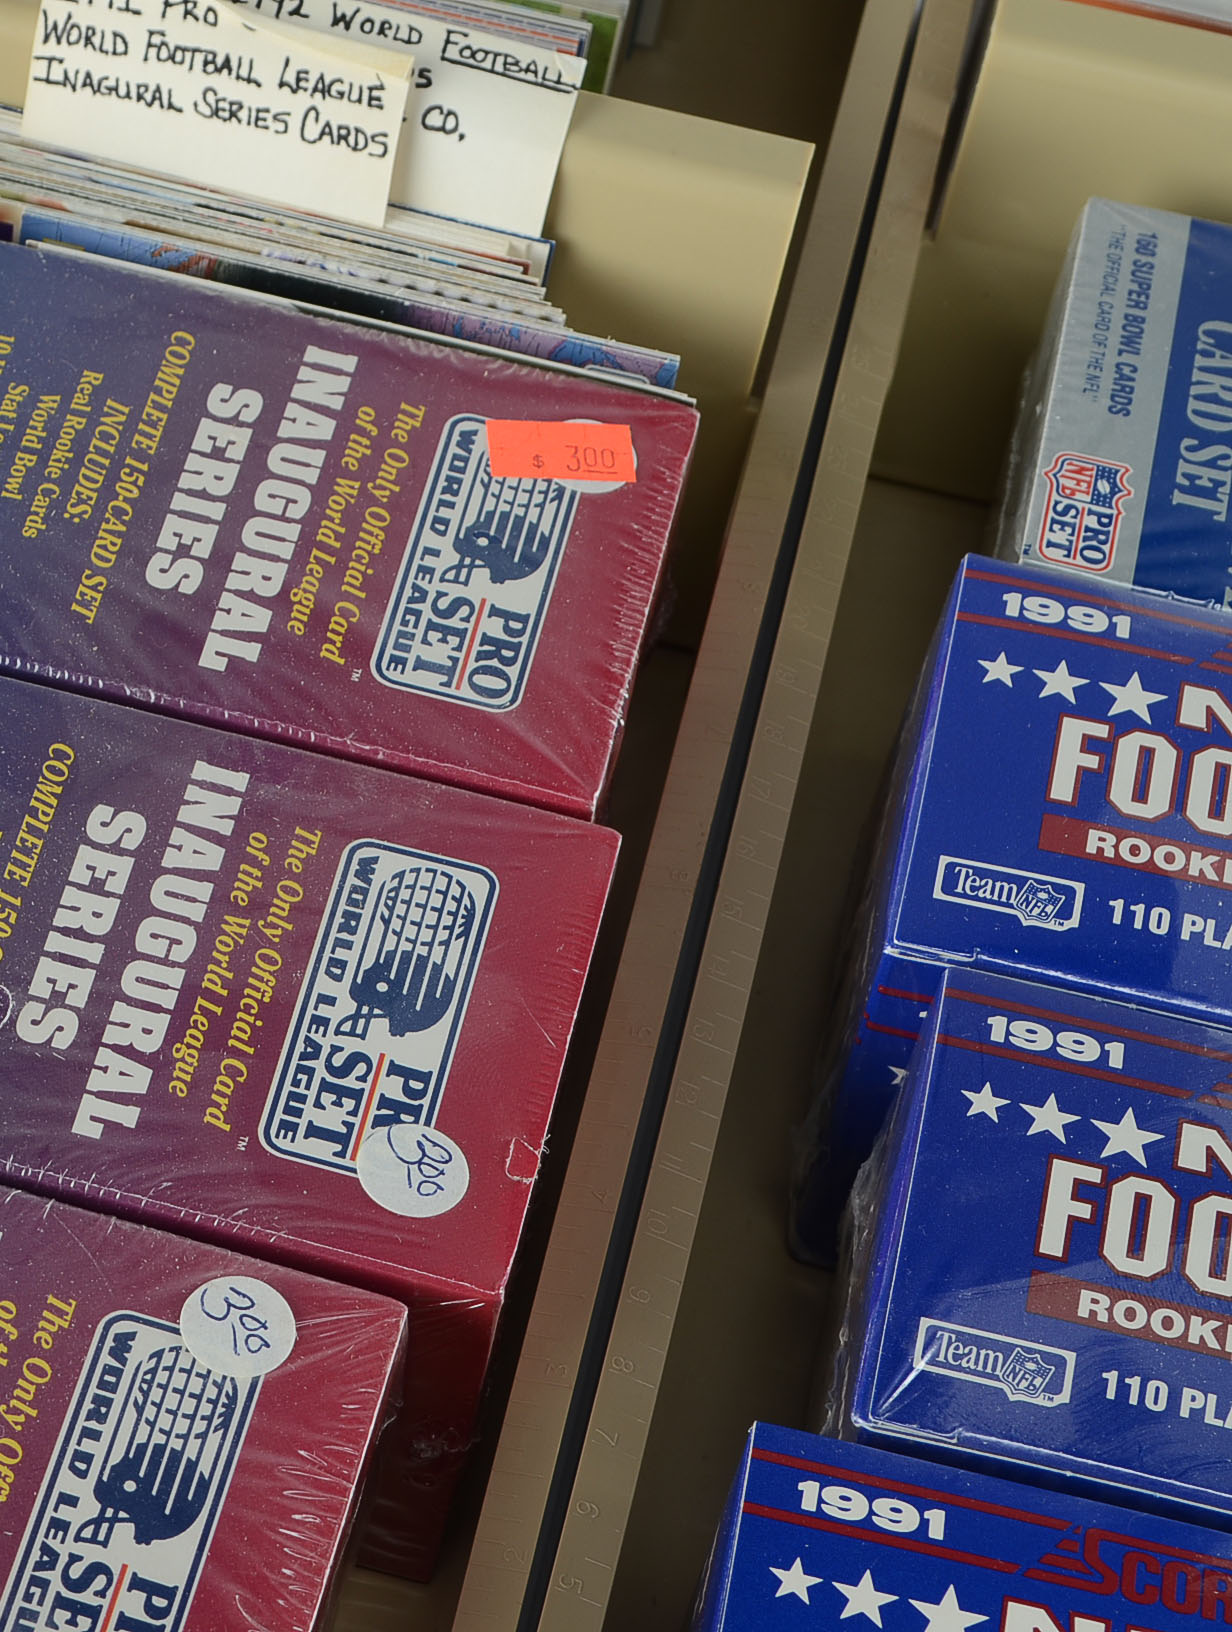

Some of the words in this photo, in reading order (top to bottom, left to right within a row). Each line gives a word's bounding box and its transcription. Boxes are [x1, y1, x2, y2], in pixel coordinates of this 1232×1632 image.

[42, 9, 129, 56] WORLD
[143, 29, 262, 88] FOOTBALL
[277, 56, 386, 110] LEAGUE
[331, 3, 423, 45] WORLD
[441, 29, 580, 91] FOOTBALL
[32, 56, 184, 113] INAGURAL
[193, 86, 292, 134] SERIES
[300, 105, 390, 158] CARDS
[1100, 257, 1122, 297] OFFICIAL
[1126, 258, 1156, 311] SUPER
[1092, 333, 1109, 349] OF
[1094, 301, 1114, 332] CARD
[1117, 313, 1147, 357] BOWL
[70, 370, 104, 413] Real
[131, 330, 196, 456] COMPLETE
[1086, 350, 1106, 373] THE
[1108, 362, 1139, 418] CARDS
[1187, 320, 1232, 432] CARD
[21, 393, 61, 450] World
[44, 413, 87, 480] Rookie
[341, 433, 372, 472] the
[355, 405, 378, 437] of
[390, 401, 426, 443] The
[1, 451, 38, 501] Bowl
[62, 398, 131, 524] INCLUDES:
[144, 382, 264, 595] SERIES
[367, 447, 410, 504] Only
[429, 428, 479, 537] WORLD
[1059, 462, 1095, 497] NFL
[1172, 437, 1232, 522] SET
[22, 482, 60, 539] Cards
[90, 456, 149, 569] 150-CARD
[197, 344, 359, 672] INAUGURAL
[316, 475, 361, 549] World
[1045, 499, 1080, 558] SET
[1079, 507, 1114, 565] PRO
[344, 505, 391, 599] Official
[71, 568, 107, 624] SET
[287, 547, 336, 637] League
[385, 545, 442, 676] LEAGUE
[1002, 592, 1132, 640] 1991
[319, 600, 360, 665] Card
[411, 589, 476, 690] SET
[467, 602, 531, 700] PRO
[4, 742, 75, 887] COMPLETE
[245, 830, 271, 866] of
[284, 825, 323, 874] The
[230, 861, 267, 906] the
[258, 879, 304, 947] Only
[954, 866, 1017, 904] Team
[1019, 892, 1051, 919] NFL
[1109, 898, 1171, 936] 110
[15, 803, 148, 1050] SERIES
[71, 759, 251, 1140] INAUGURAL
[201, 913, 251, 989] World
[322, 854, 380, 983] WORLD
[230, 947, 283, 1055] Official
[168, 994, 223, 1098] League
[275, 992, 338, 1143] LEAGUE
[987, 1015, 1125, 1070] 1991
[203, 1056, 248, 1132] Card
[302, 1043, 374, 1160] SET
[371, 1057, 434, 1130] PR
[32, 1294, 77, 1350] The
[0, 1356, 52, 1431] Only
[935, 1331, 1004, 1375] Team
[1006, 1365, 1038, 1393] NFL
[1102, 1370, 1169, 1412] 110
[68, 1330, 138, 1480] WORLD
[797, 1480, 946, 1541] 1991
